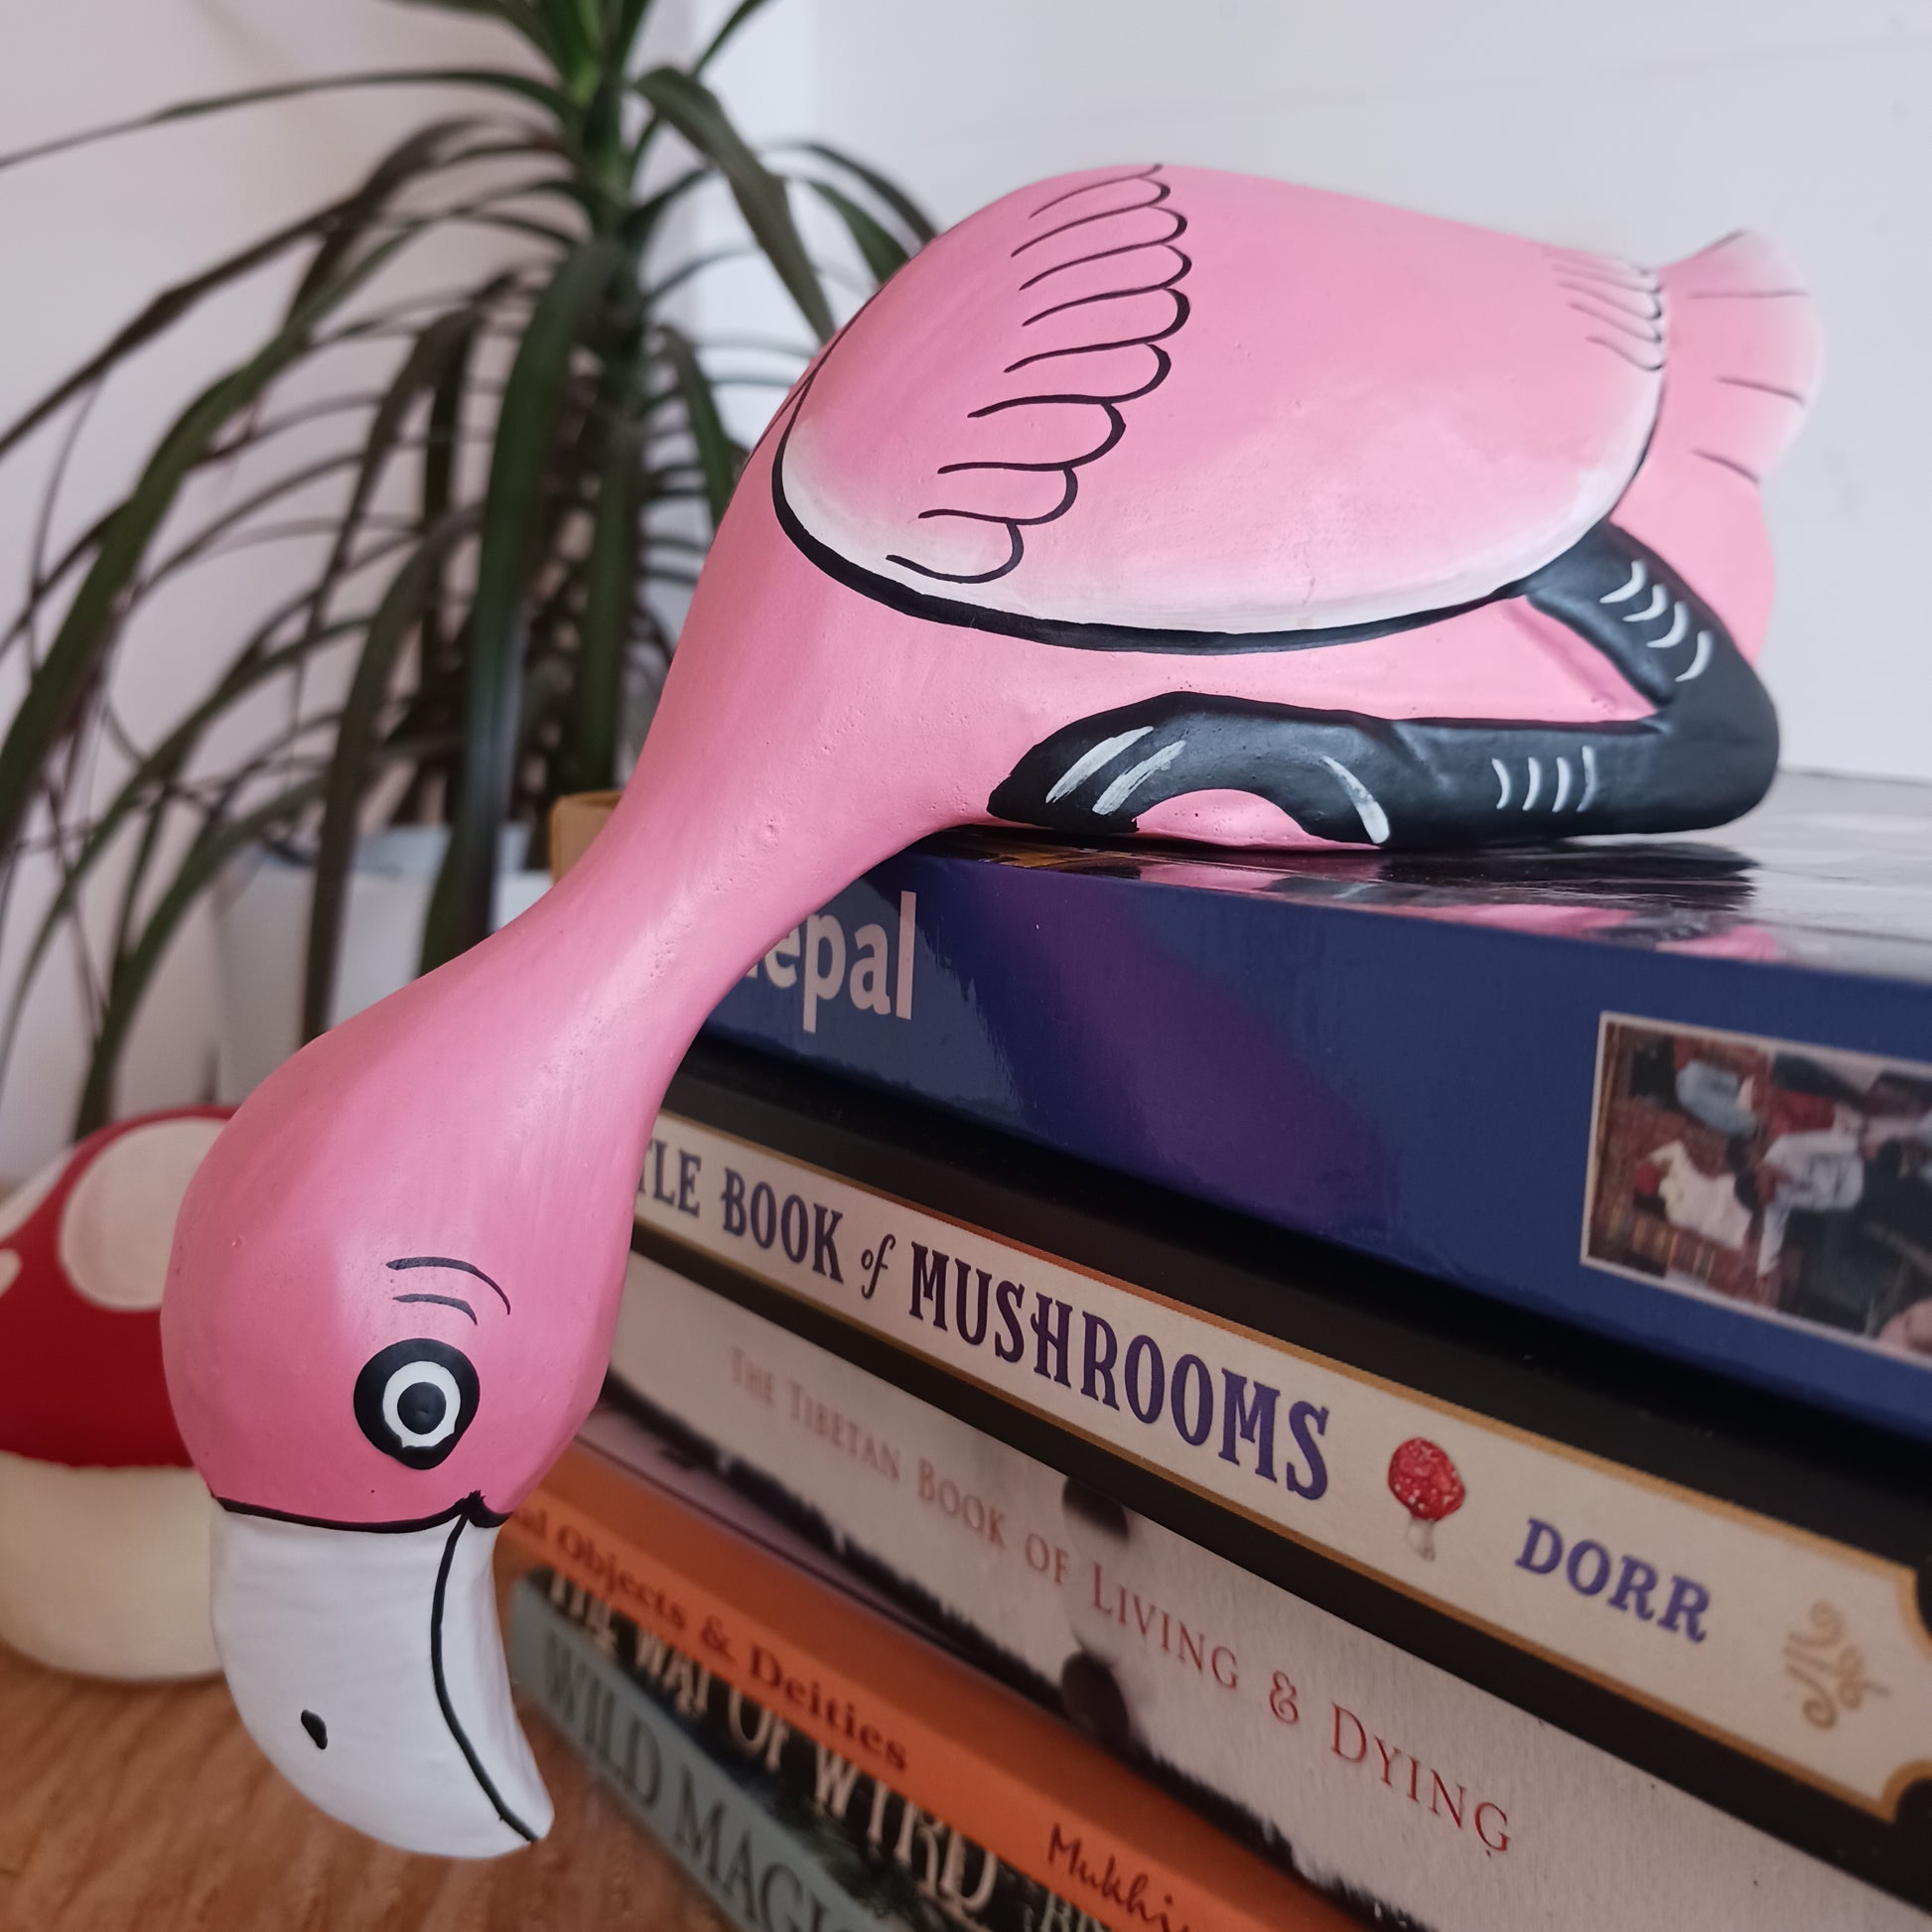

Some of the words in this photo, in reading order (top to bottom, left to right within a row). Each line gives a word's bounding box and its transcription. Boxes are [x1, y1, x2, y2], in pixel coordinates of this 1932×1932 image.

[747, 891, 916, 1034] epal
[721, 1166, 843, 1285] BOOK
[861, 1233, 896, 1299] of
[908, 1241, 1329, 1500] MUSHROOMS
[556, 1524, 687, 1631] Objects
[700, 1615, 737, 1664] &
[750, 1644, 907, 1773] Deities
[917, 1457, 1007, 1551] BOOK
[1025, 1533, 1069, 1586] OF
[1093, 1563, 1239, 1690] LIVING
[1269, 1670, 1299, 1725] &
[1331, 1702, 1510, 1853] DYING
[1514, 1517, 1711, 1643] DORR
[1047, 1823, 1193, 1932] Mukhi
